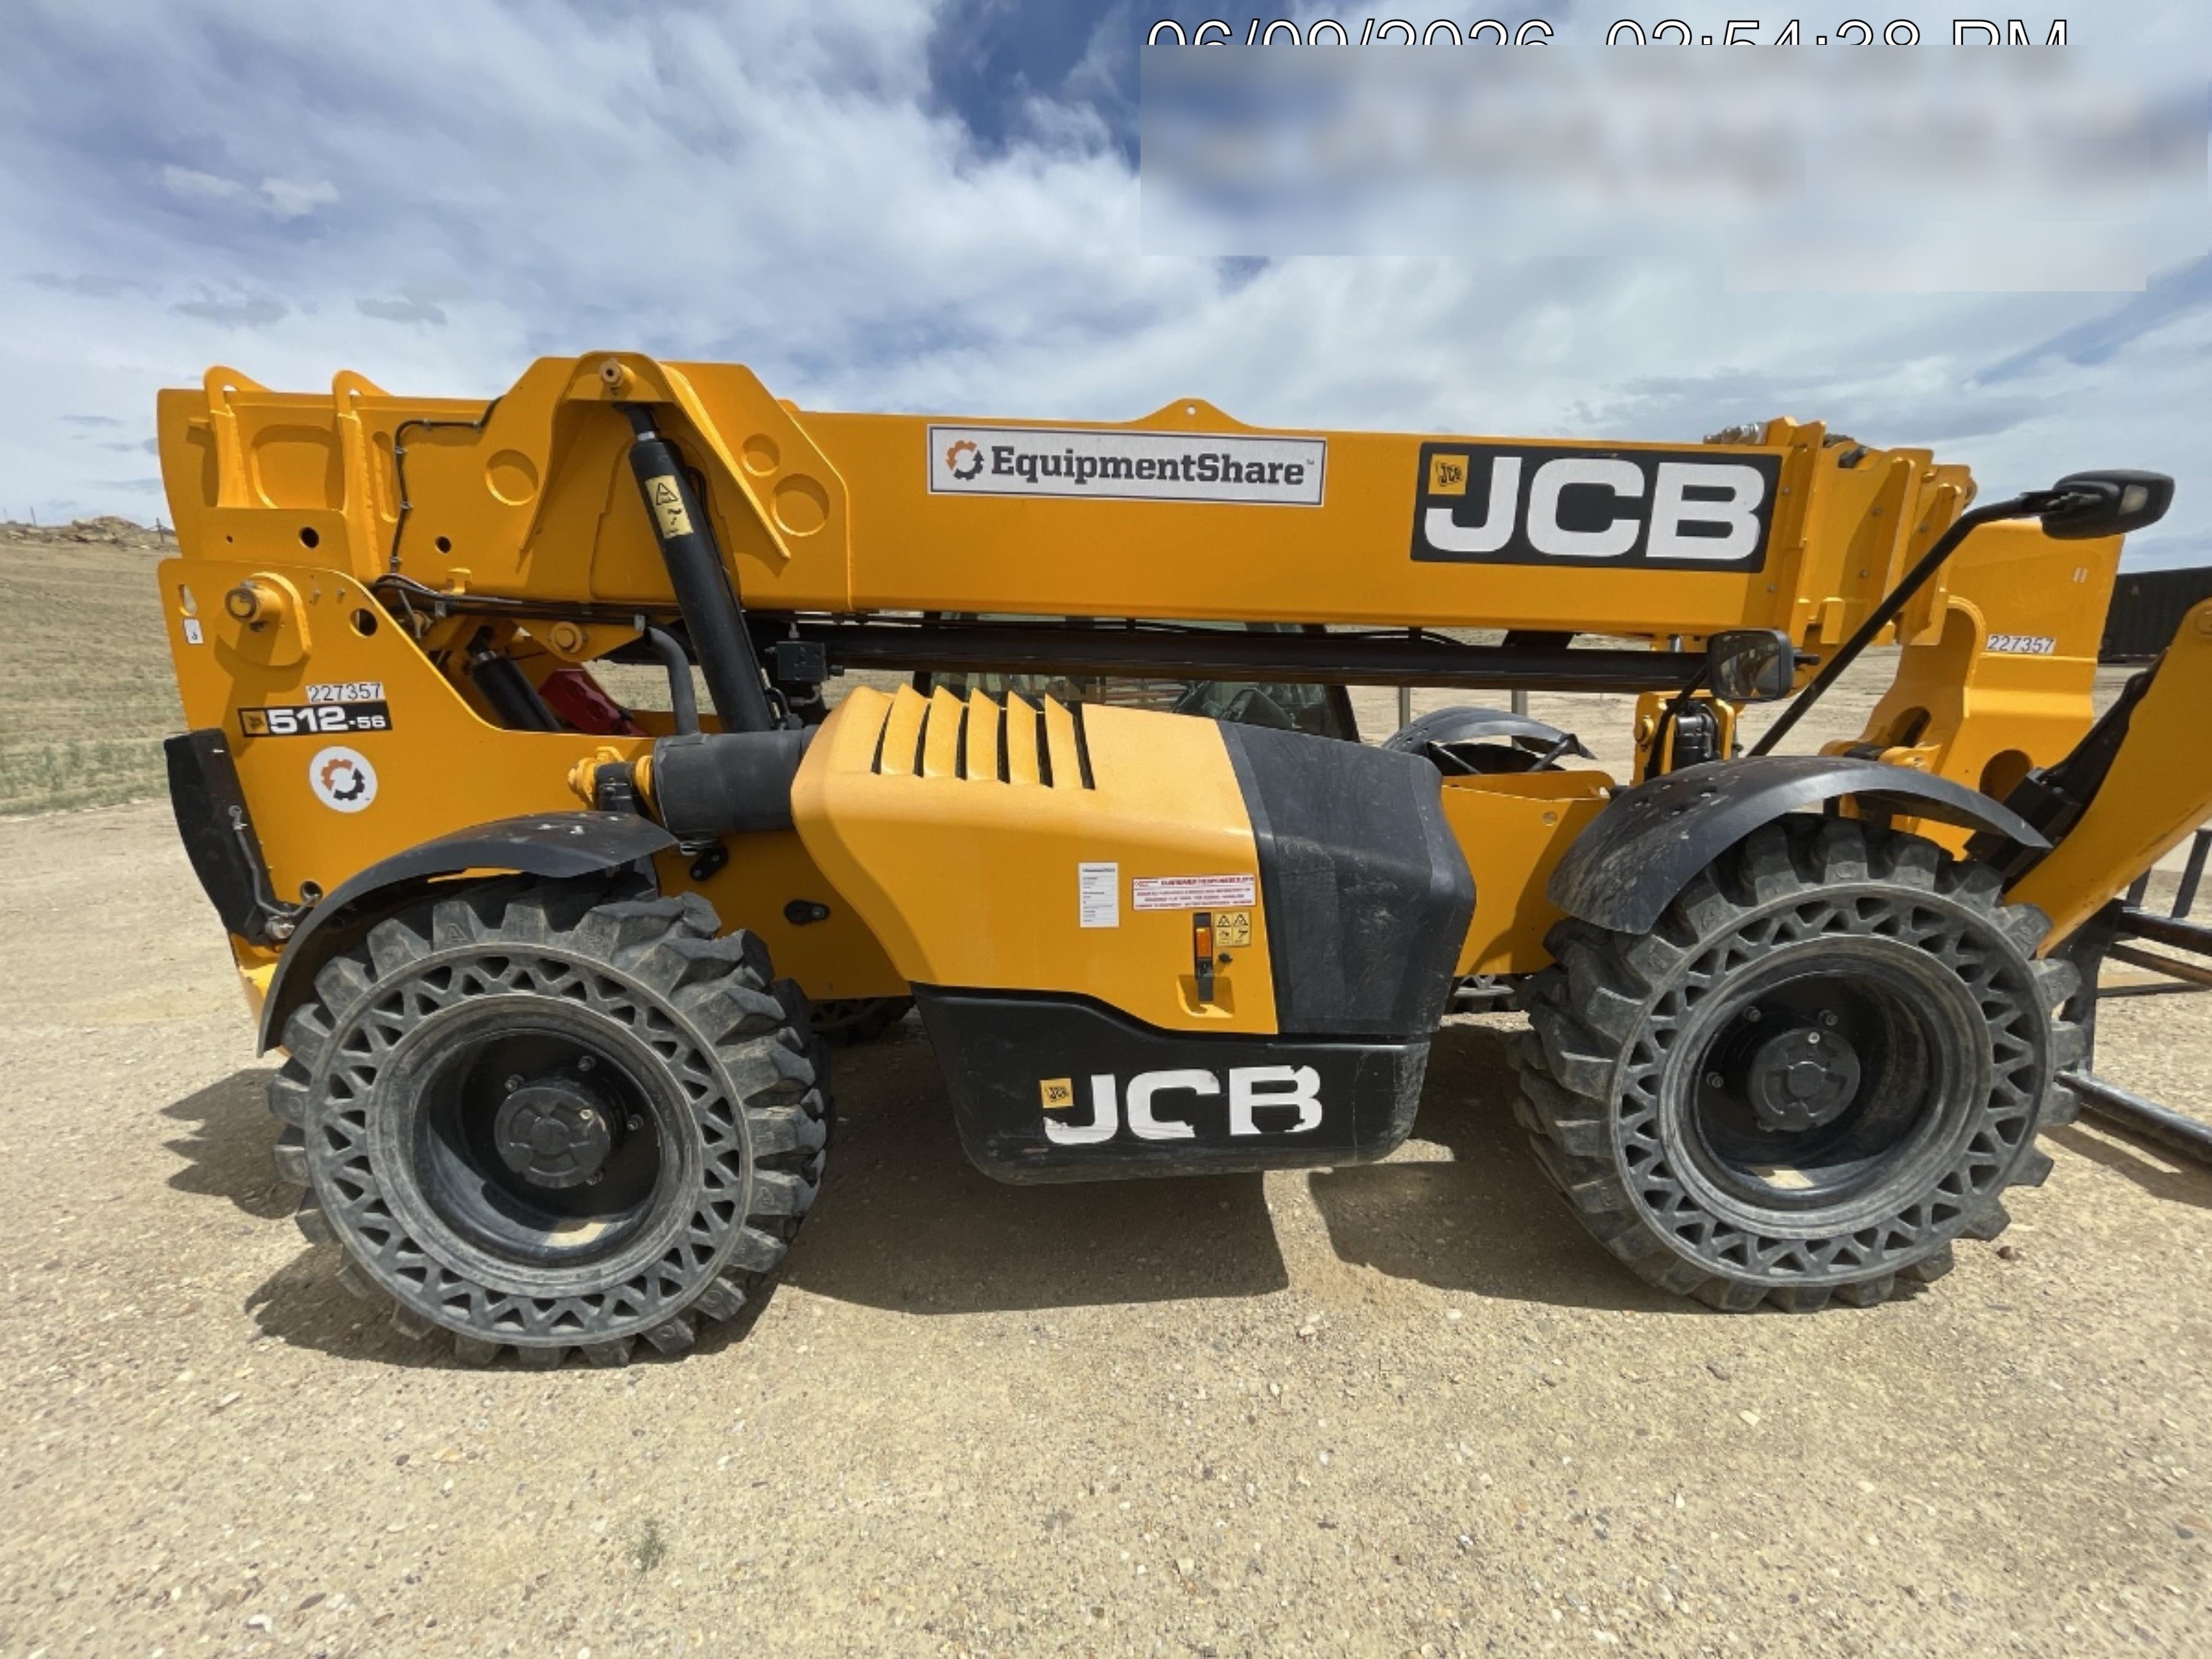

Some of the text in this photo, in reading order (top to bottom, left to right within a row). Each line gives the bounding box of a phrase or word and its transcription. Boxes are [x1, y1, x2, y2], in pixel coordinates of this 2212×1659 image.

[991, 445, 1305, 486] EquipmentShare
[1424, 457, 1765, 560] JCB
[1988, 635, 2054, 653] 227357
[308, 683, 381, 702] 227357
[1043, 1065, 1323, 1145] JCB
